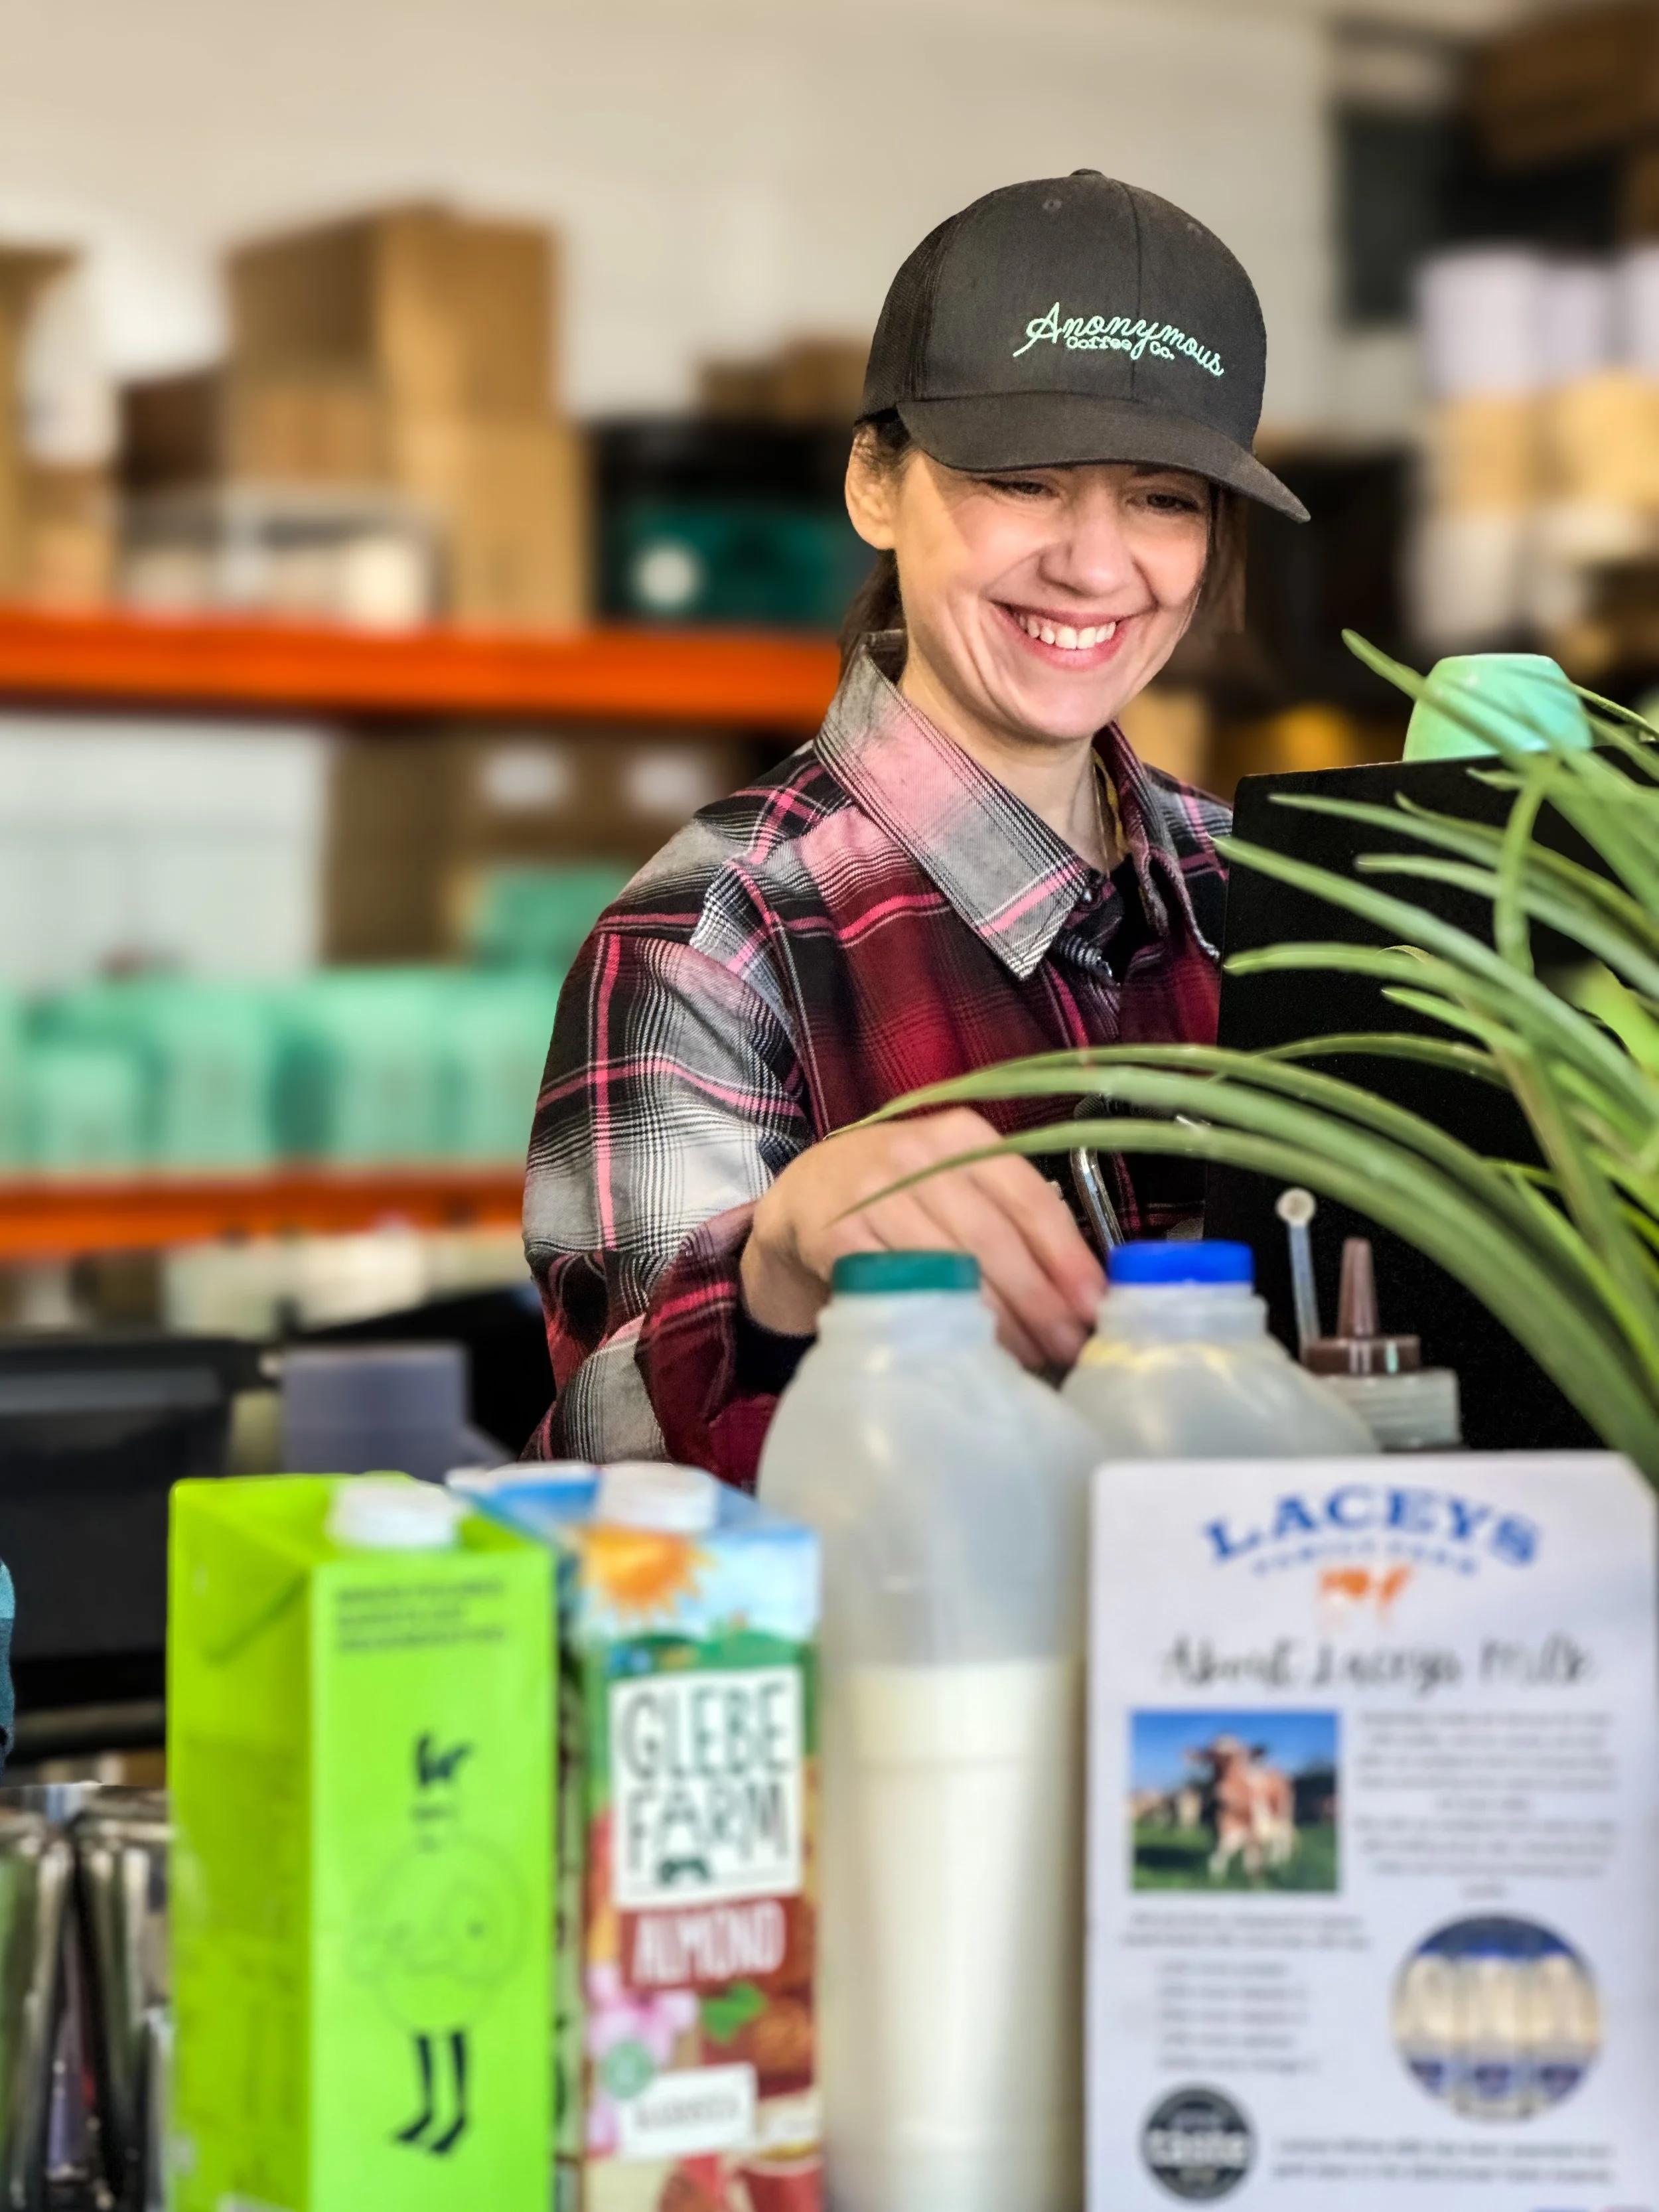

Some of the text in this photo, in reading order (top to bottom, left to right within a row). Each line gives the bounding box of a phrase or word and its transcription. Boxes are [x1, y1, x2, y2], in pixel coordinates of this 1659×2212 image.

[1013, 302, 1224, 376] Anonymous
[1066, 336, 1176, 360] Coffee Co.
[1203, 1484, 1541, 1566] LACEYS
[1161, 1633, 1295, 1687] About
[1479, 1631, 1594, 1686] Milk
[620, 1680, 792, 1784] GLEBE
[624, 1780, 790, 1877] FARM
[632, 1899, 786, 1983] ALMOND
